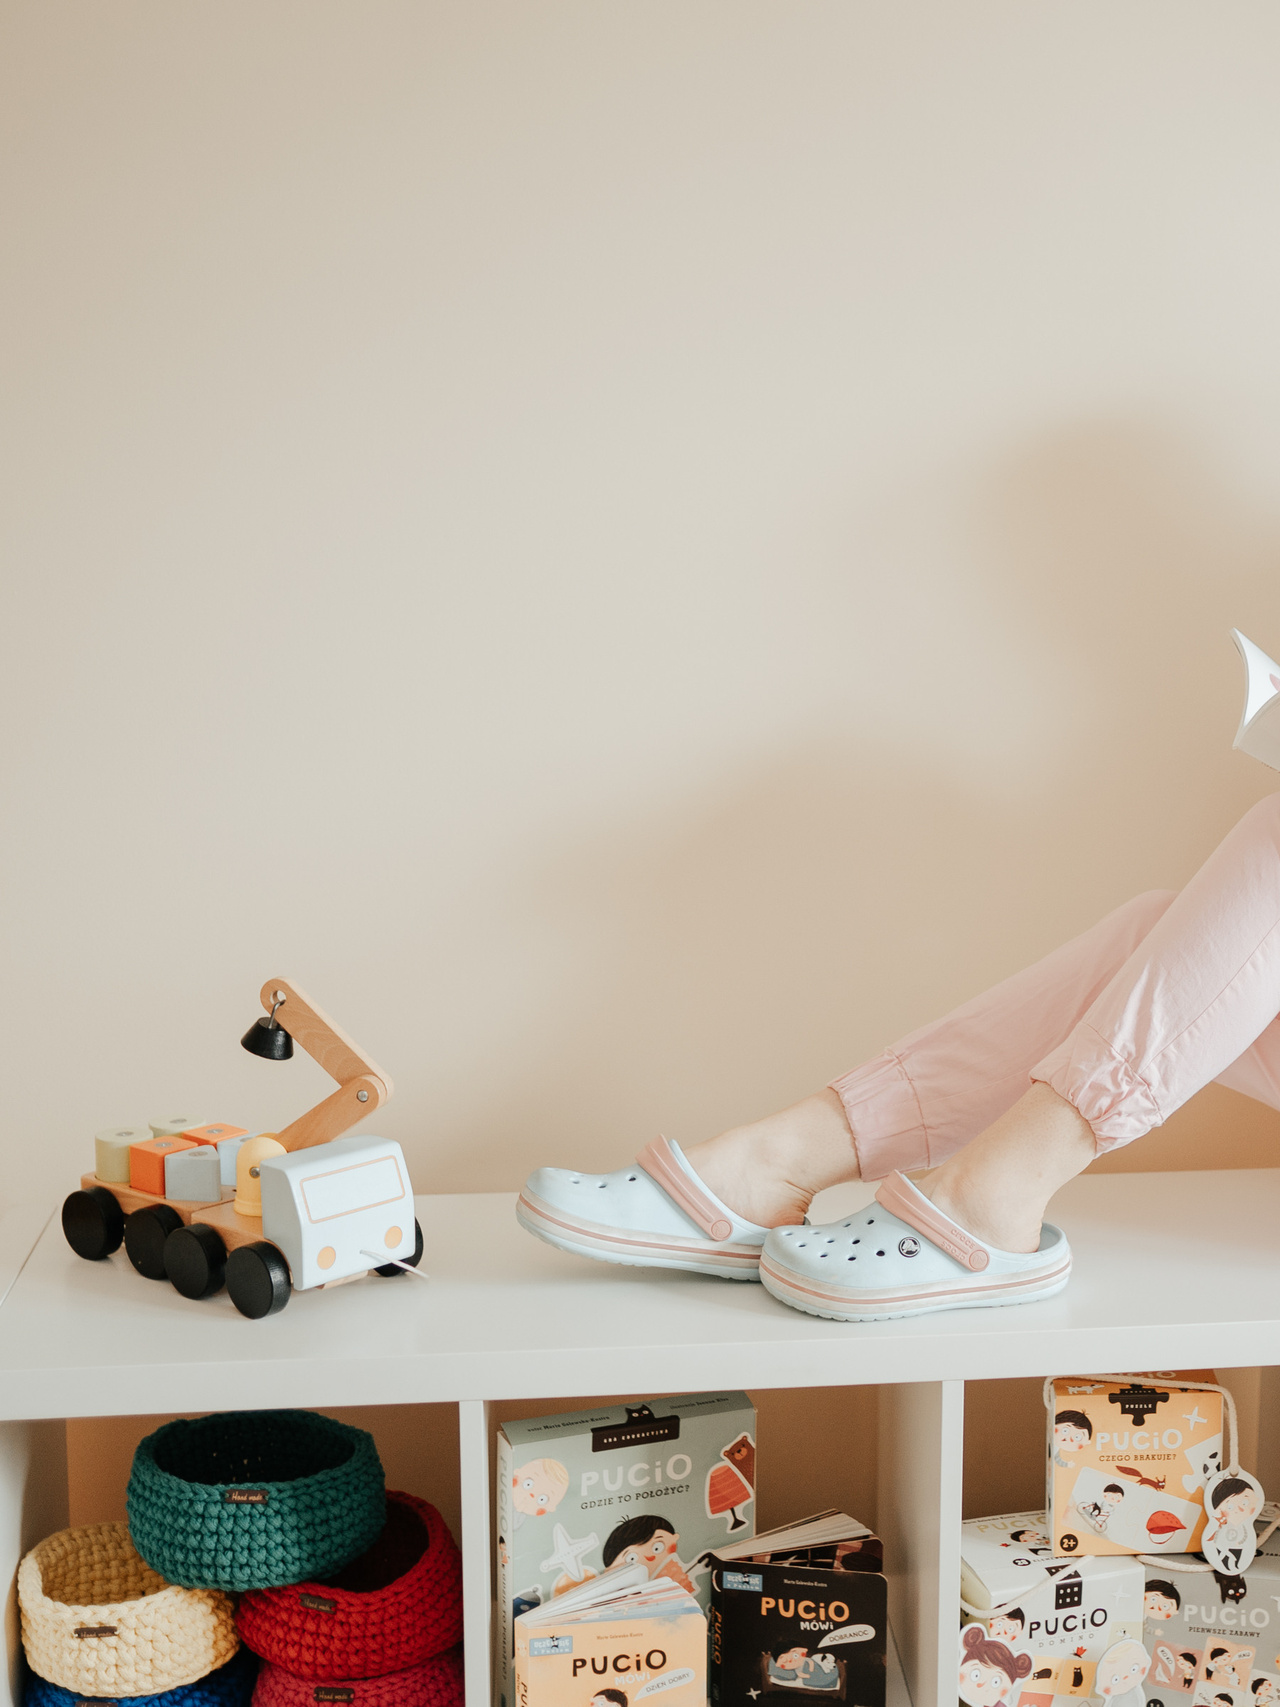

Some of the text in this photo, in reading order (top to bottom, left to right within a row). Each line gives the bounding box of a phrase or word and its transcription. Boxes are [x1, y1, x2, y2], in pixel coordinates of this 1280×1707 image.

[951, 1228, 976, 1249] crocs
[1098, 1454, 1131, 1462] CZEGO
[232, 1490, 262, 1501] Hand made
[580, 1484, 690, 1510] GDZIE TO POŁOŻYĆ?
[1062, 1538, 1076, 1548] 2+
[828, 1629, 869, 1643] DOBRANOC
[1188, 1626, 1261, 1638] PIERWSZE ZABAWY
[1038, 1632, 1094, 1648] DOMINO
[319, 1690, 334, 1700] Hand
